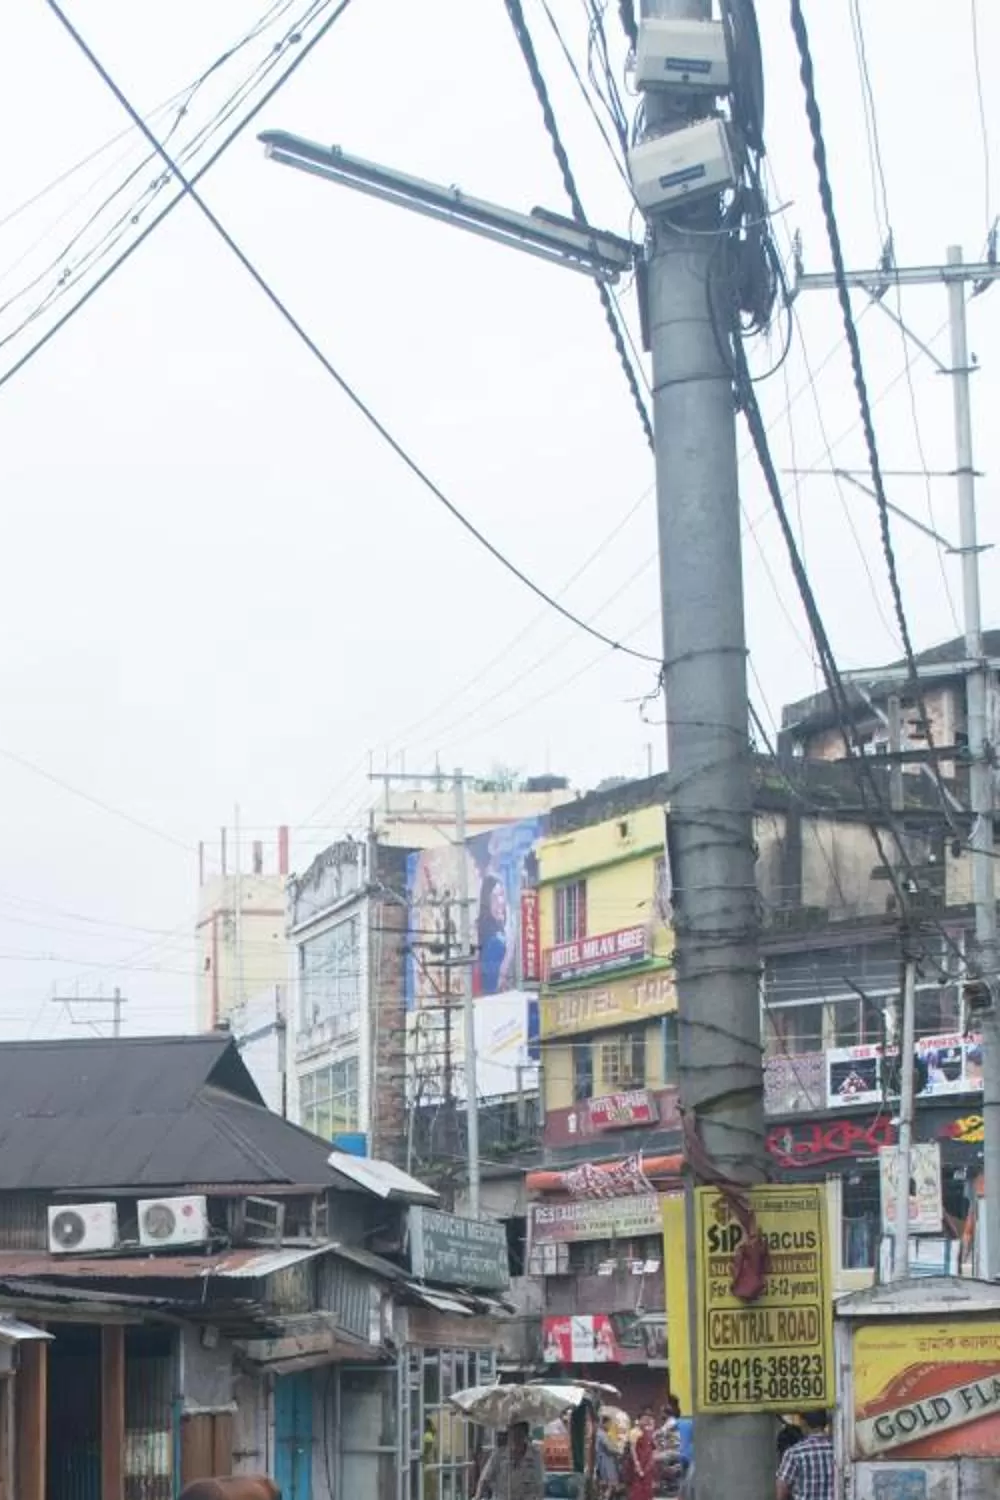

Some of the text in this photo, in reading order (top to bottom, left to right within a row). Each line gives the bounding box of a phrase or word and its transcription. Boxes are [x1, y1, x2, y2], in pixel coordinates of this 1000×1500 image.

[711, 1308, 817, 1345] CENTRAL ROAD
[709, 1355, 823, 1380] 94016-36823
[709, 1377, 823, 1401] 80115-08690
[873, 1396, 952, 1441] GOLD
